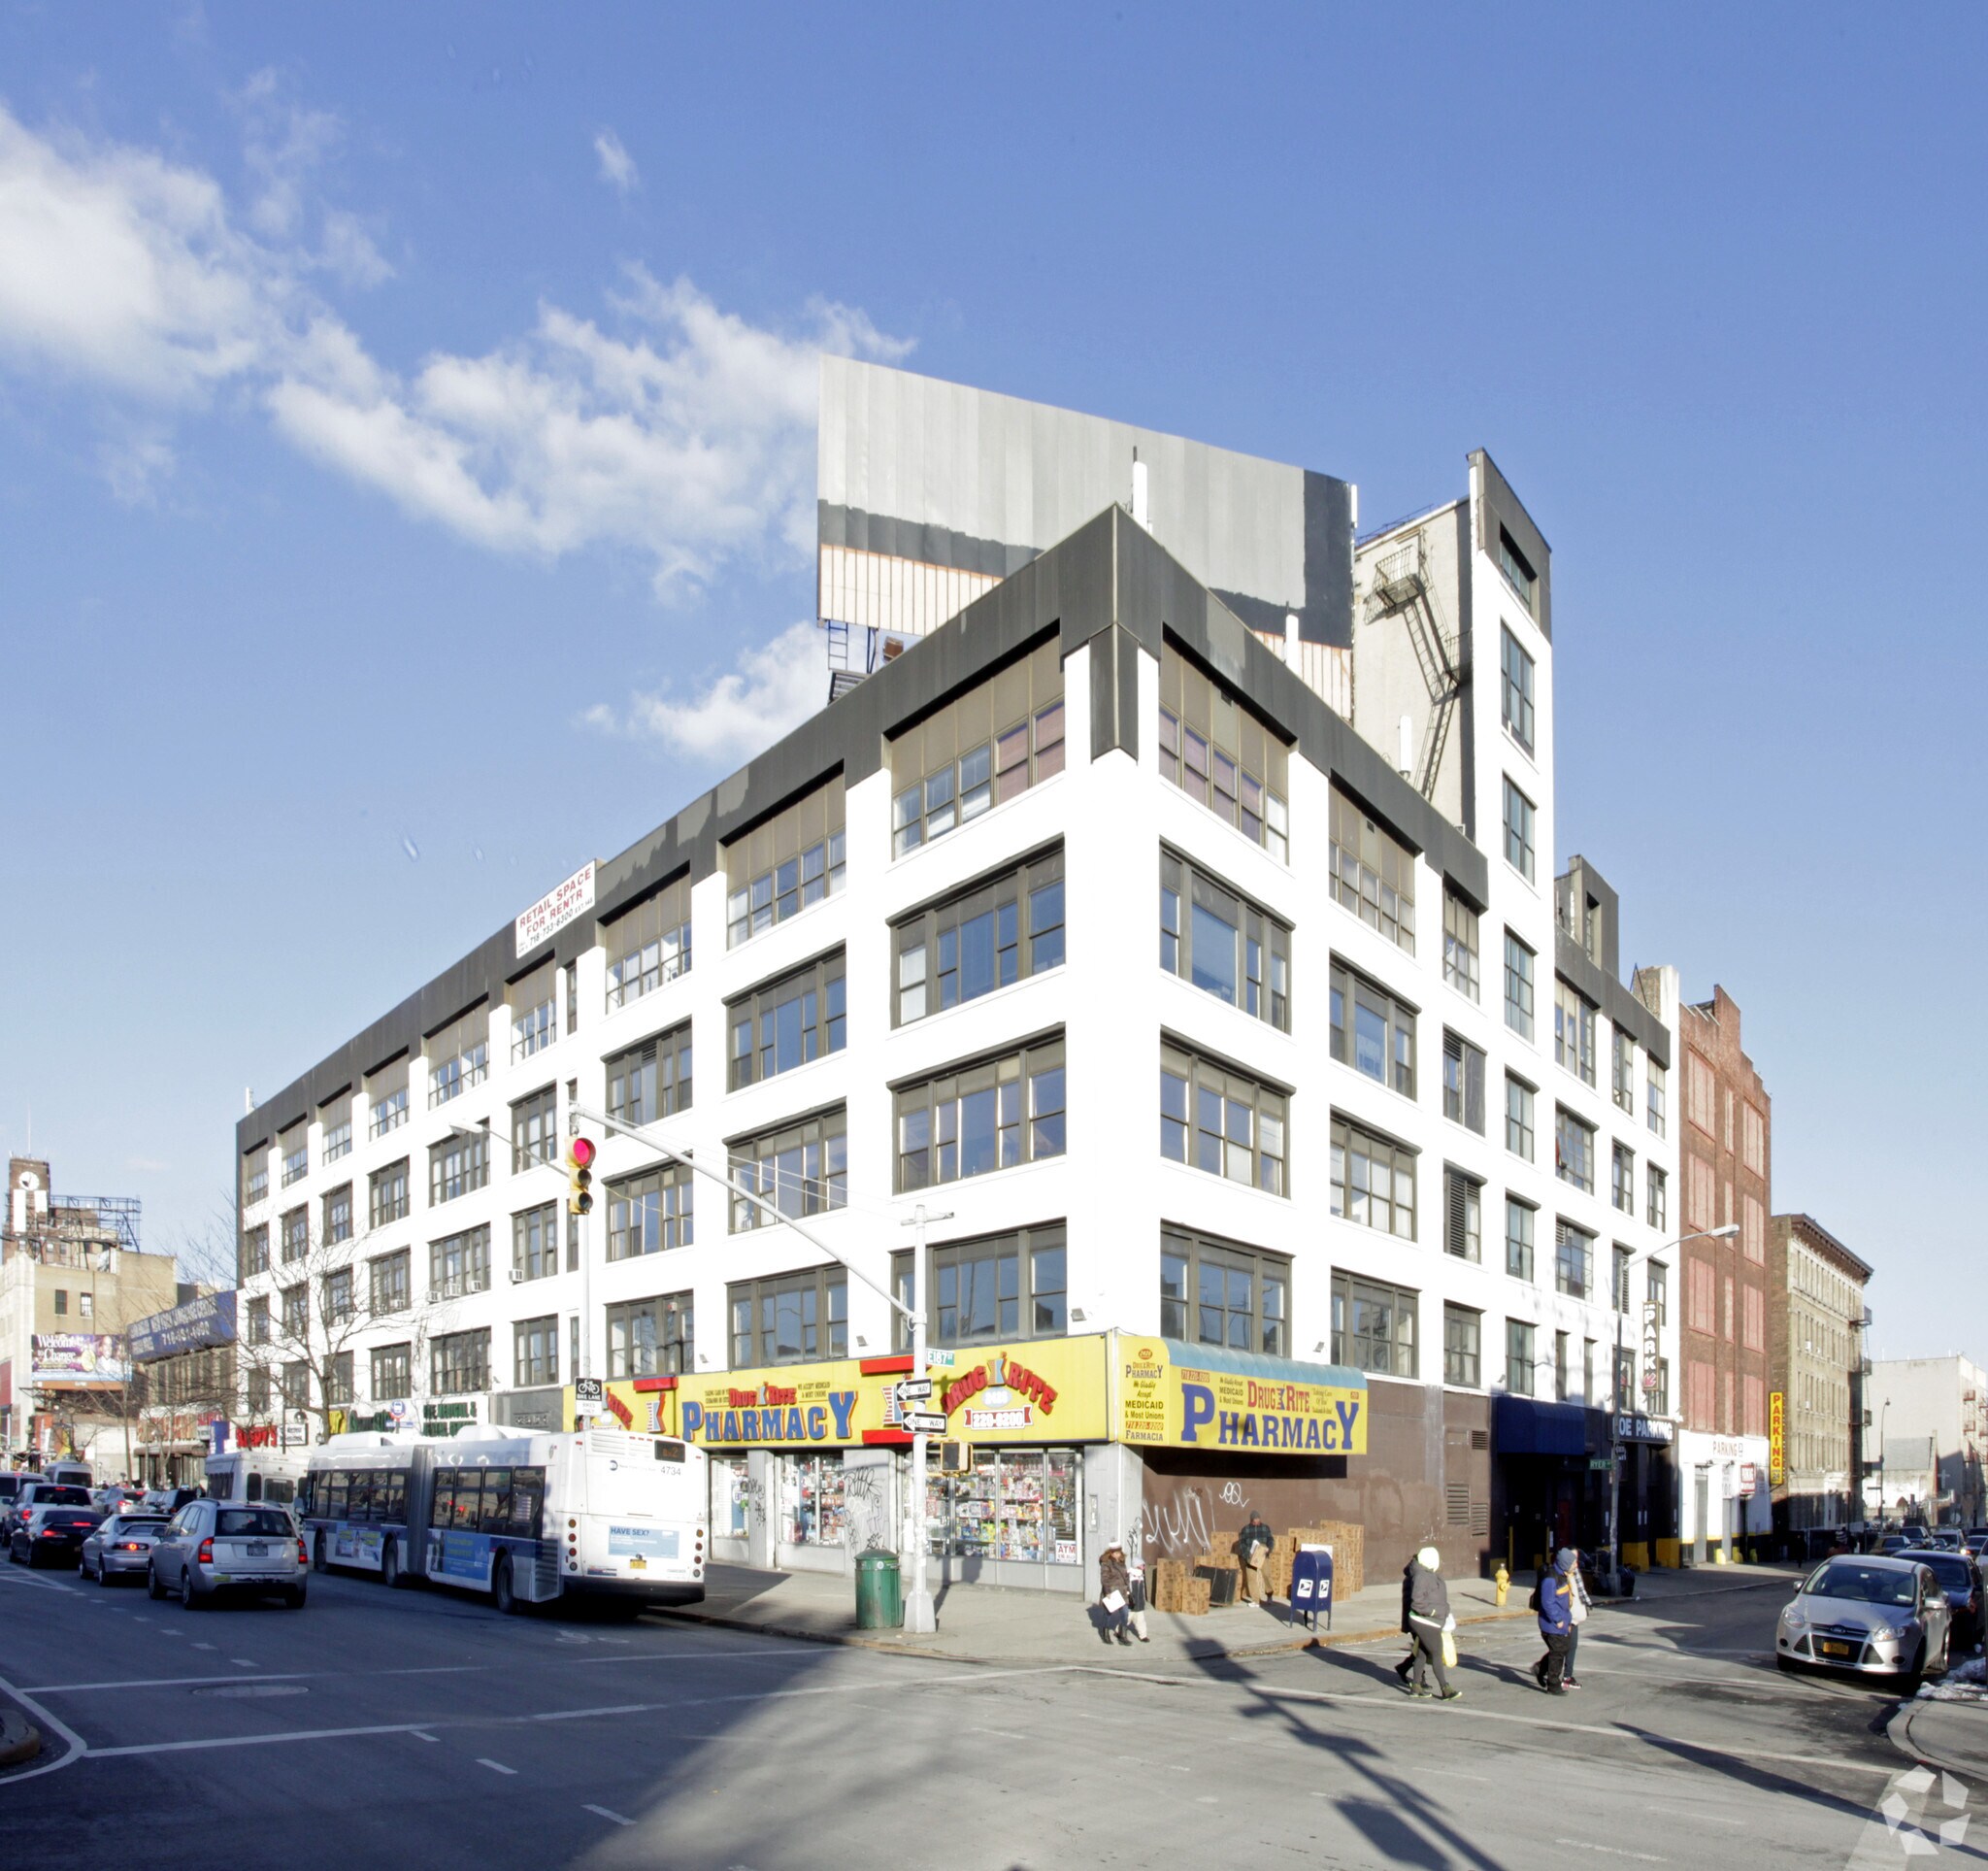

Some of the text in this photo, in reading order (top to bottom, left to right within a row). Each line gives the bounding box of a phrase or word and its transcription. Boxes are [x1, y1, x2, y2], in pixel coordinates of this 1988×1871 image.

[519, 867, 591, 928] RETAIL SPACE
[526, 917, 545, 937] FOR
[1643, 1310, 1656, 1370] PARK
[1126, 1365, 1163, 1379] PHARMACY
[729, 1386, 797, 1408] DRUG RITE
[900, 1387, 911, 1395] ONE
[941, 1361, 1058, 1417] DRUG RITE
[1219, 1387, 1243, 1396] MEDICAID
[1247, 1380, 1309, 1413] DRUG RITE
[1125, 1400, 1164, 1409] MEDICAID
[681, 1390, 858, 1442] PHARMACY
[908, 1418, 921, 1426] ONE
[1181, 1383, 1359, 1451] PHARMACY
[1126, 1430, 1163, 1441] FARMACIA
[1612, 1418, 1673, 1440] OE PARKING
[1772, 1394, 1781, 1467] PARKING
[1713, 1441, 1737, 1456] PARKING
[660, 1466, 681, 1476] 4734
